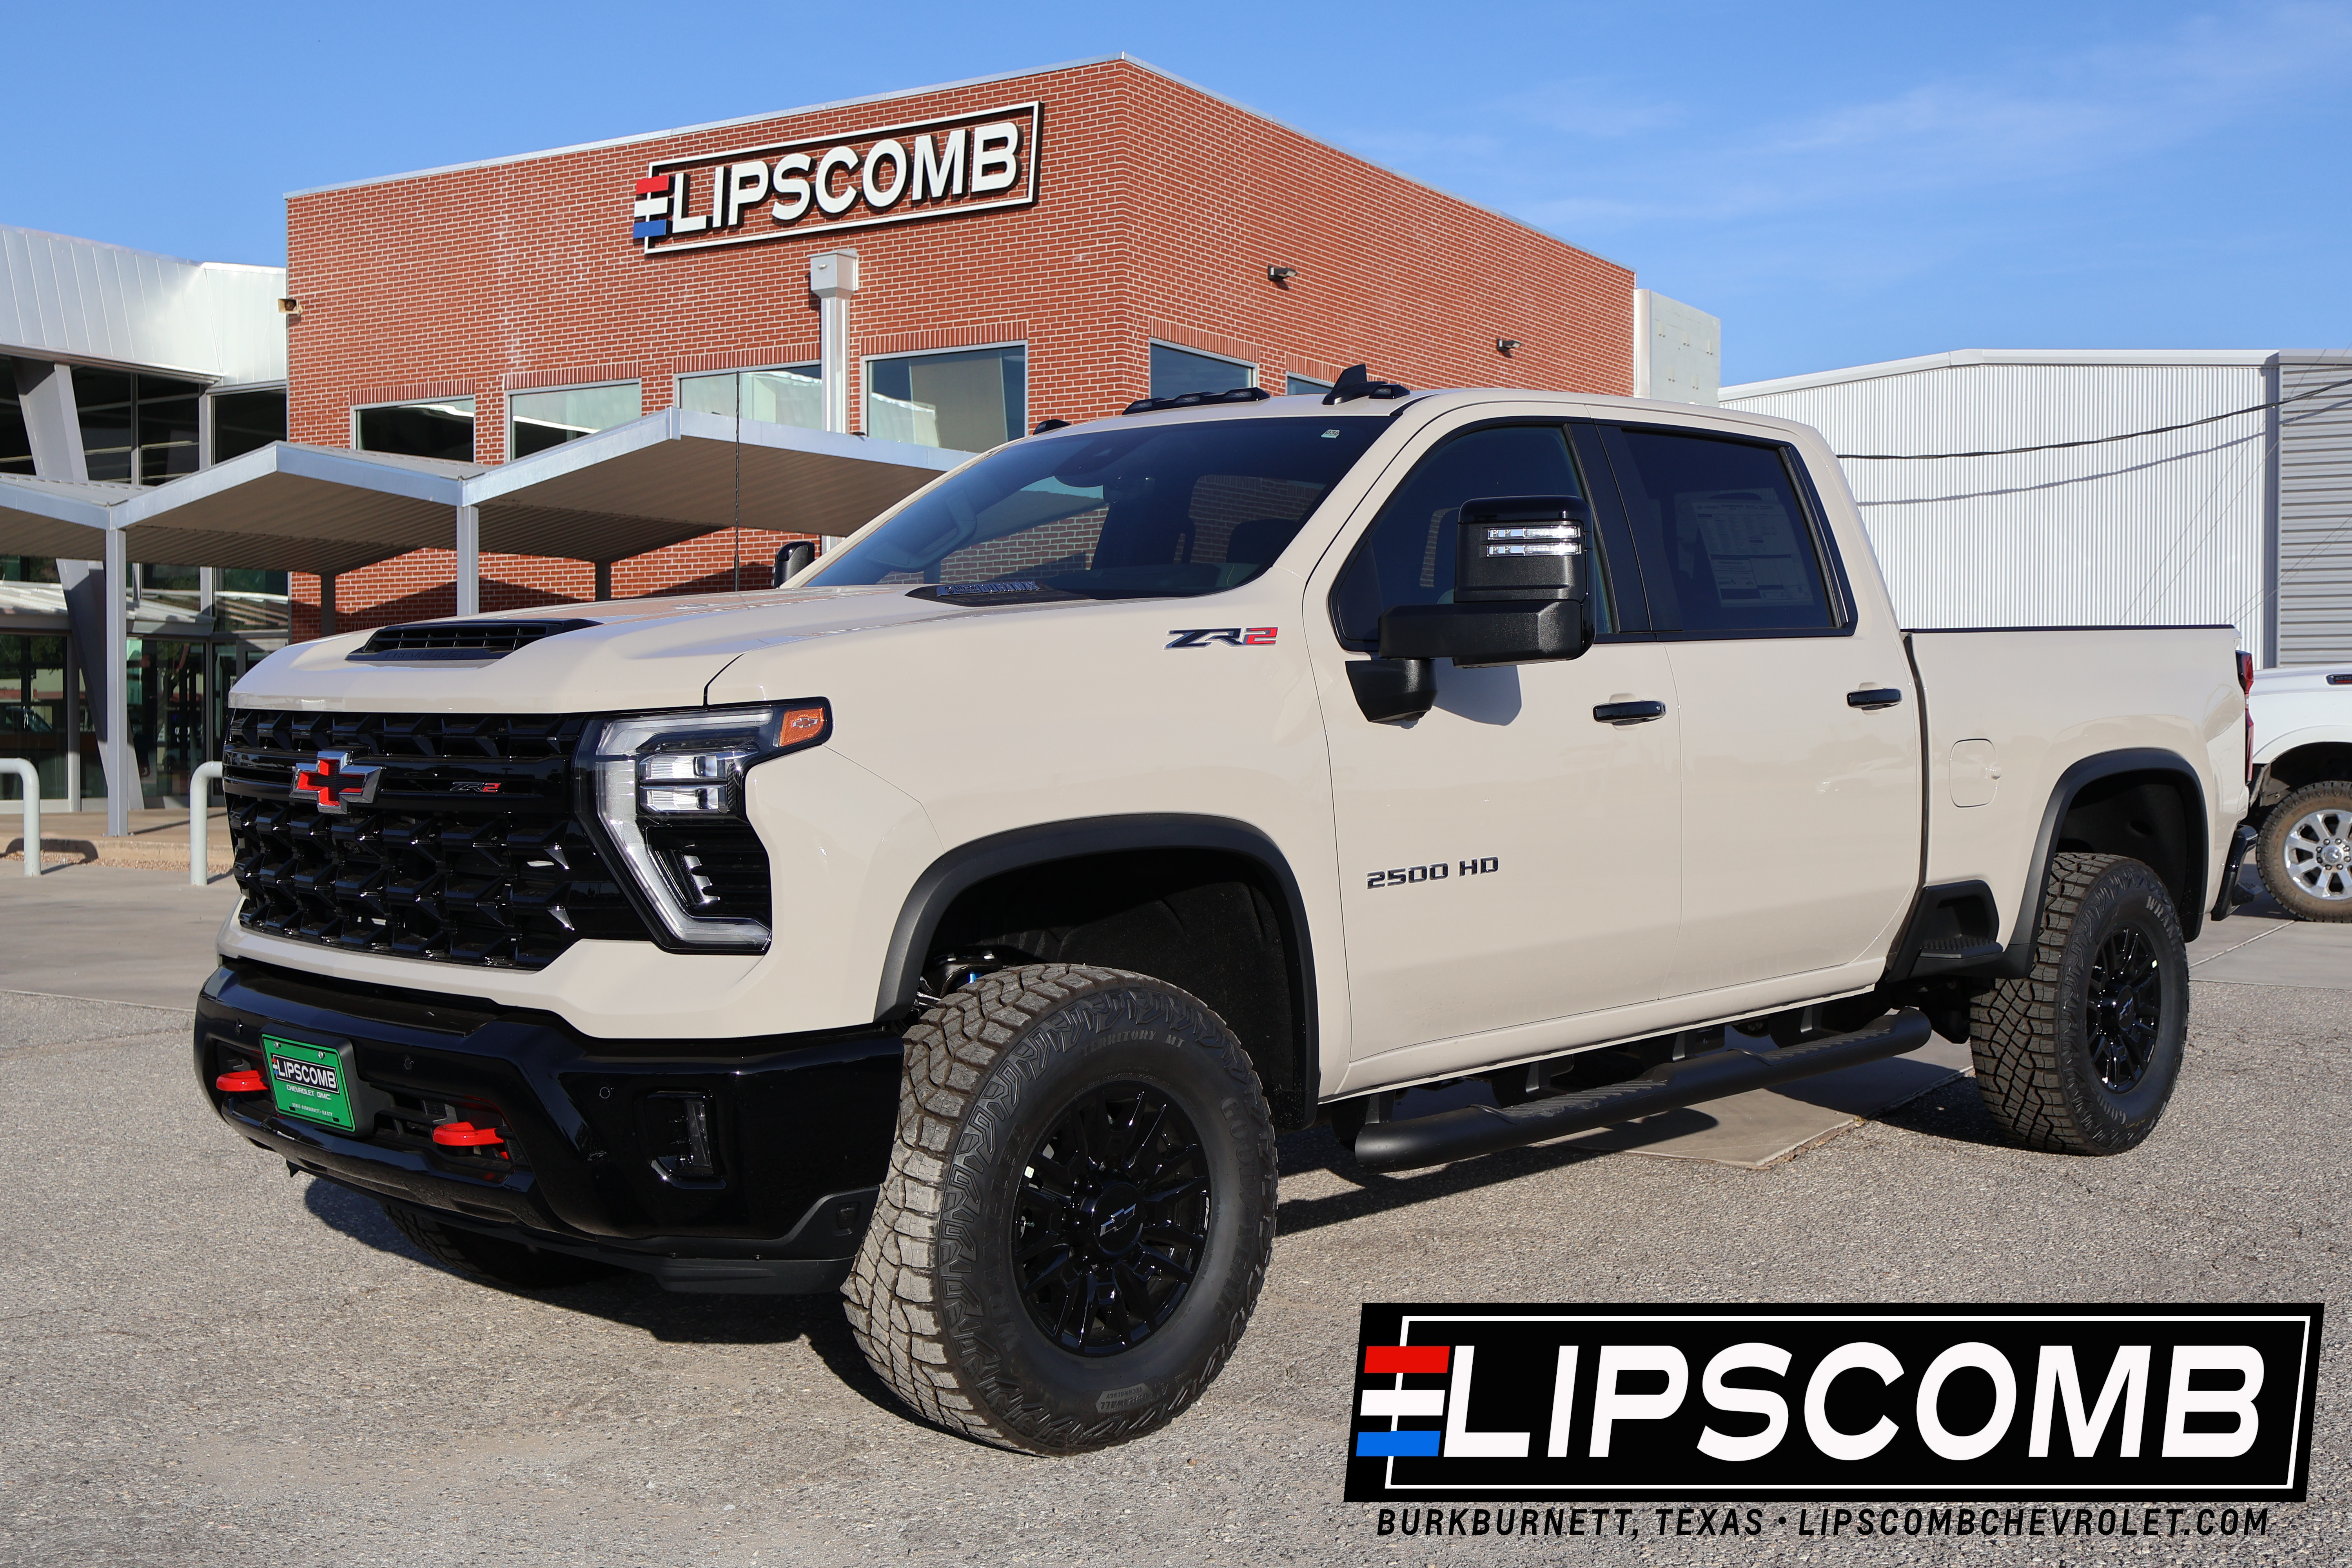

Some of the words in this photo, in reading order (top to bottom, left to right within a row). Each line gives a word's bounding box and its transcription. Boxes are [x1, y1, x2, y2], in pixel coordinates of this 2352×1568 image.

[672, 122, 1019, 234] LIPSCOMB
[1163, 626, 1278, 650] ZR2
[449, 782, 501, 793] ZR2
[1365, 862, 1448, 890] 2500
[1458, 855, 1499, 877] HD
[1081, 1030, 1156, 1057] TERRITORY
[1165, 1034, 1185, 1049] MT
[277, 1059, 336, 1089] LIPSCOMB
[286, 1084, 314, 1097] CHEVROLET
[316, 1091, 331, 1100] GMC
[982, 1122, 1029, 1352] WRANGLER
[1106, 1387, 1143, 1399] TECHNOLOGY
